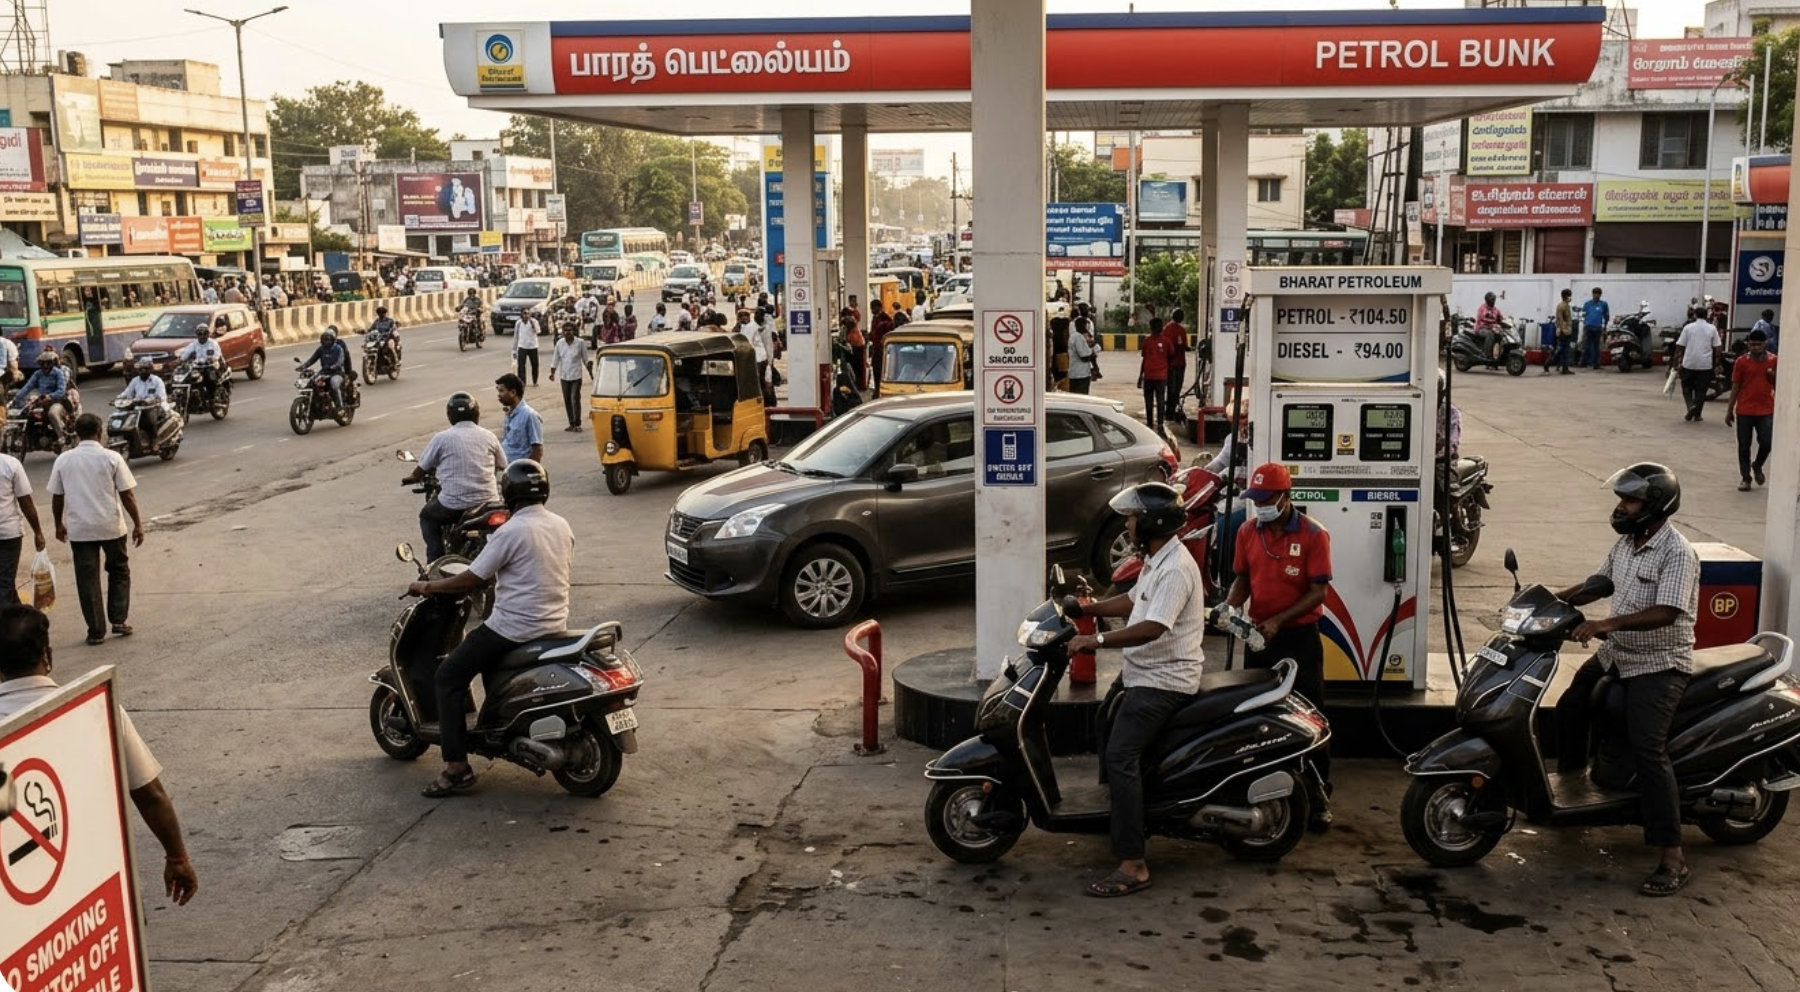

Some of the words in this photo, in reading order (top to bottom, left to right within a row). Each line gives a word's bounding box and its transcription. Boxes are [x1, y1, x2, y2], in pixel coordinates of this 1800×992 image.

[570, 42, 656, 84] பாரத்
[1316, 40, 1449, 69] PETROL
[1459, 38, 1556, 67] BUNK
[1279, 275, 1335, 289] BHARAT
[1338, 275, 1422, 289] PETROLEUM
[1277, 308, 1335, 325] PETROL
[1349, 308, 1407, 325] ₹104.50
[1277, 342, 1330, 359] DIESEL
[1353, 342, 1404, 359] ₹94.00
[1714, 598, 1736, 613] BP
[7, 967, 23, 992] O
[26, 898, 107, 982] SMOKING
[89, 925, 119, 971] OFF
